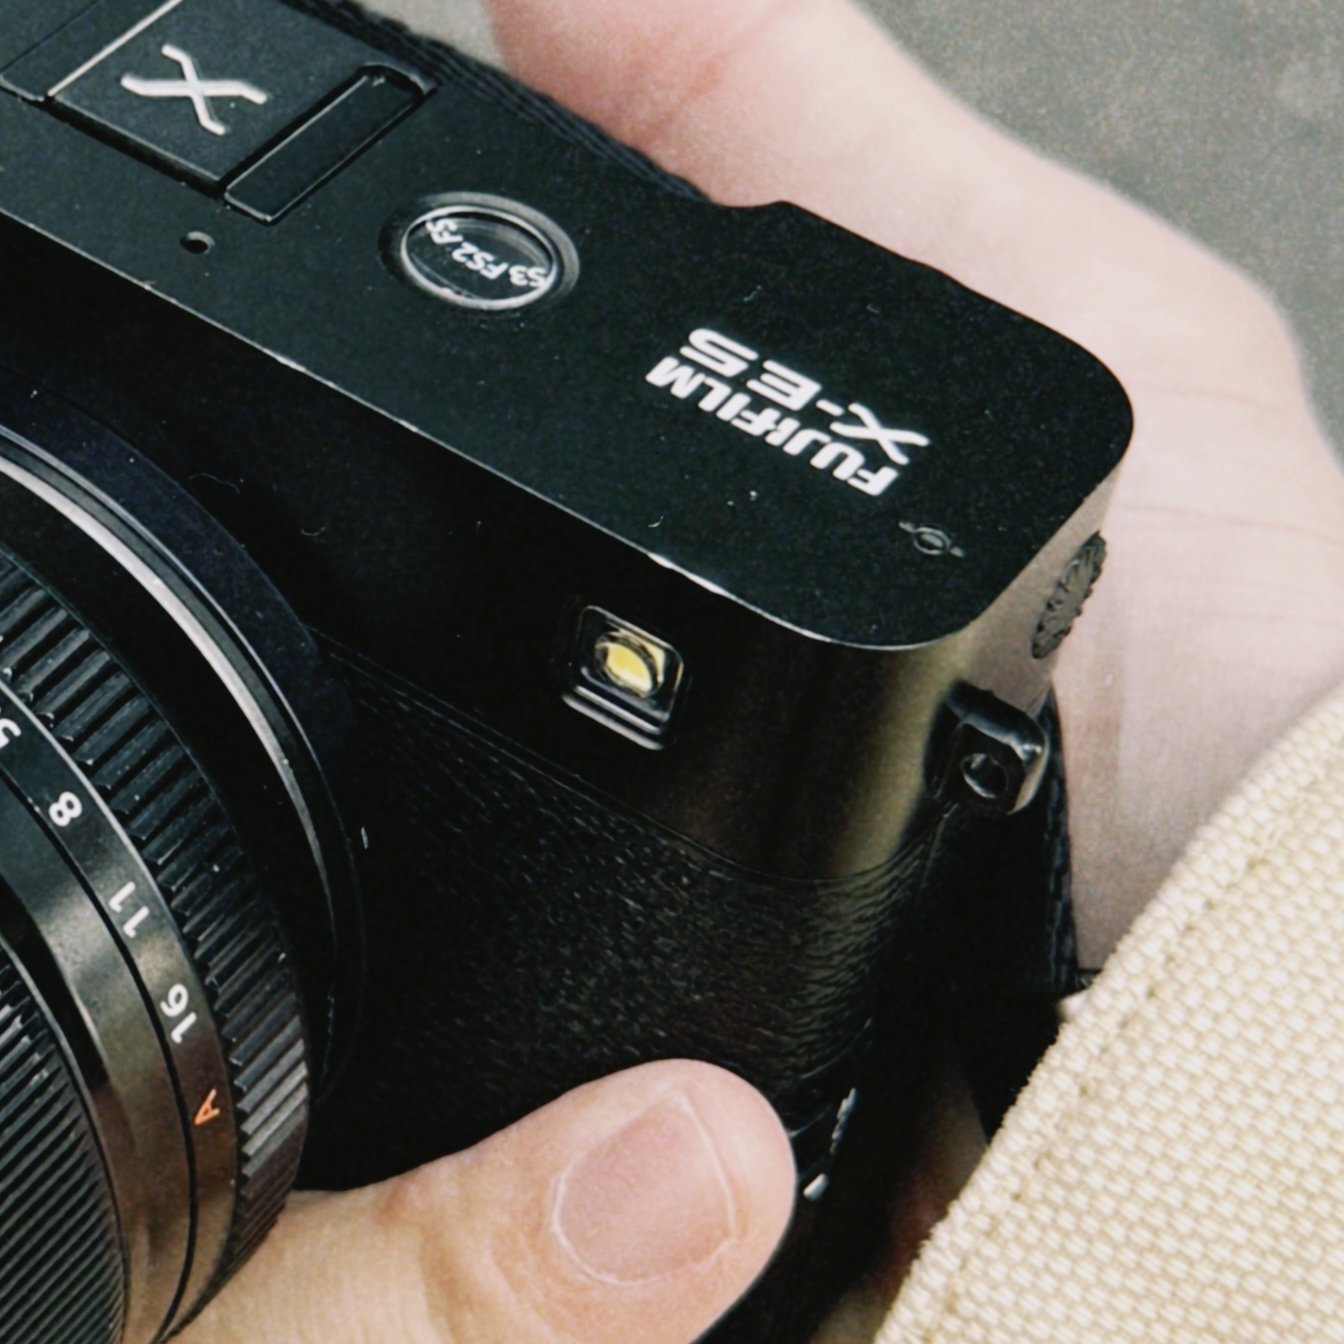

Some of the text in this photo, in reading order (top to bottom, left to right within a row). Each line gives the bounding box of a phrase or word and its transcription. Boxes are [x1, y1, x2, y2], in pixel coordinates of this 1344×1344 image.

[121, 43, 268, 136] X
[425, 219, 549, 289] S3 FS2 FS
[645, 356, 899, 497] FUJIFILM
[679, 328, 931, 465] X-E5
[48, 791, 83, 827] 8
[108, 881, 150, 938] 11
[160, 984, 197, 1044] 16
[193, 1089, 220, 1126] A
